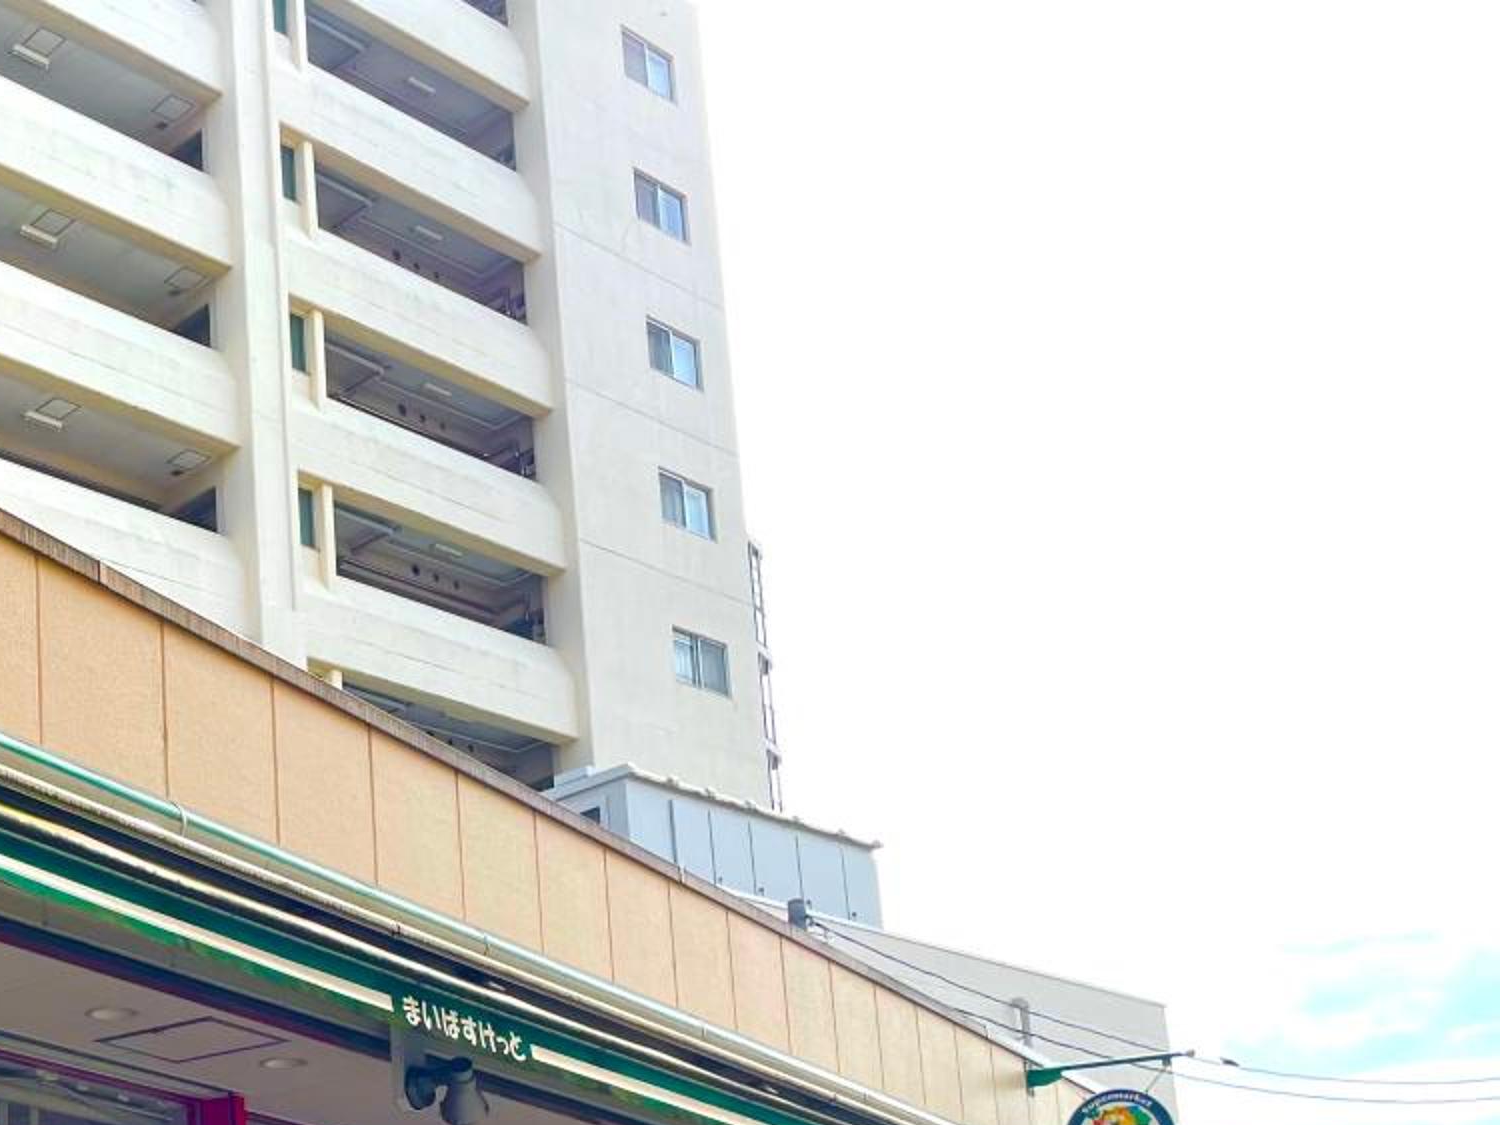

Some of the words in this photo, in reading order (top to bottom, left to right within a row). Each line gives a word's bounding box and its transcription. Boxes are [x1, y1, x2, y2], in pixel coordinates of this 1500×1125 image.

[401, 994, 526, 1062] まいばすけっと
